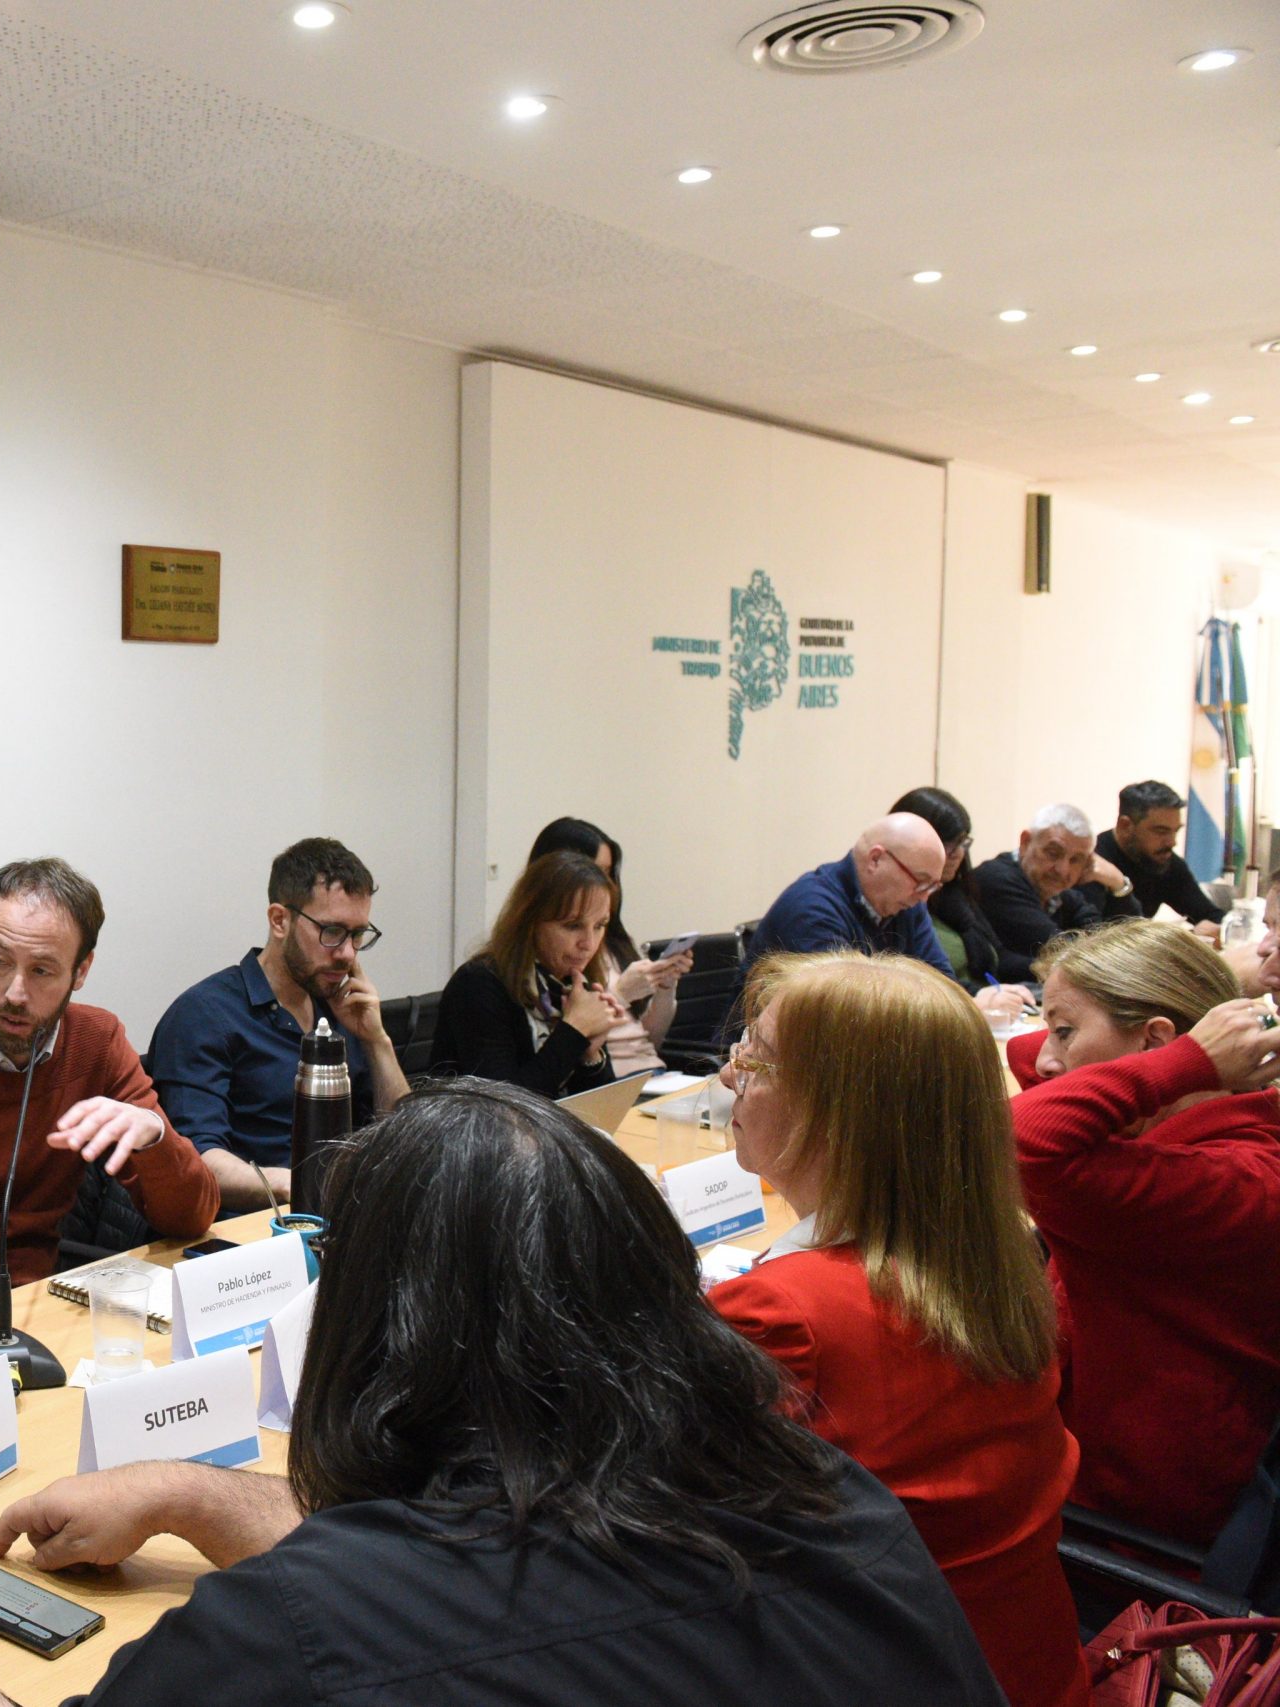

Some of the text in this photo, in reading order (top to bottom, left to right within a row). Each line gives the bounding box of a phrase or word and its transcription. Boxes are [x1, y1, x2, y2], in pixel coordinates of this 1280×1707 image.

[799, 653, 855, 679] BUENOS
[797, 684, 840, 709] AIRES
[704, 1180, 728, 1197] SADOP
[217, 1270, 272, 1294] Pablo López
[200, 1300, 227, 1314] MINISTRO
[227, 1297, 235, 1307] DE
[235, 1290, 262, 1304] HACIENDA
[144, 1397, 209, 1431] SUTEBA
